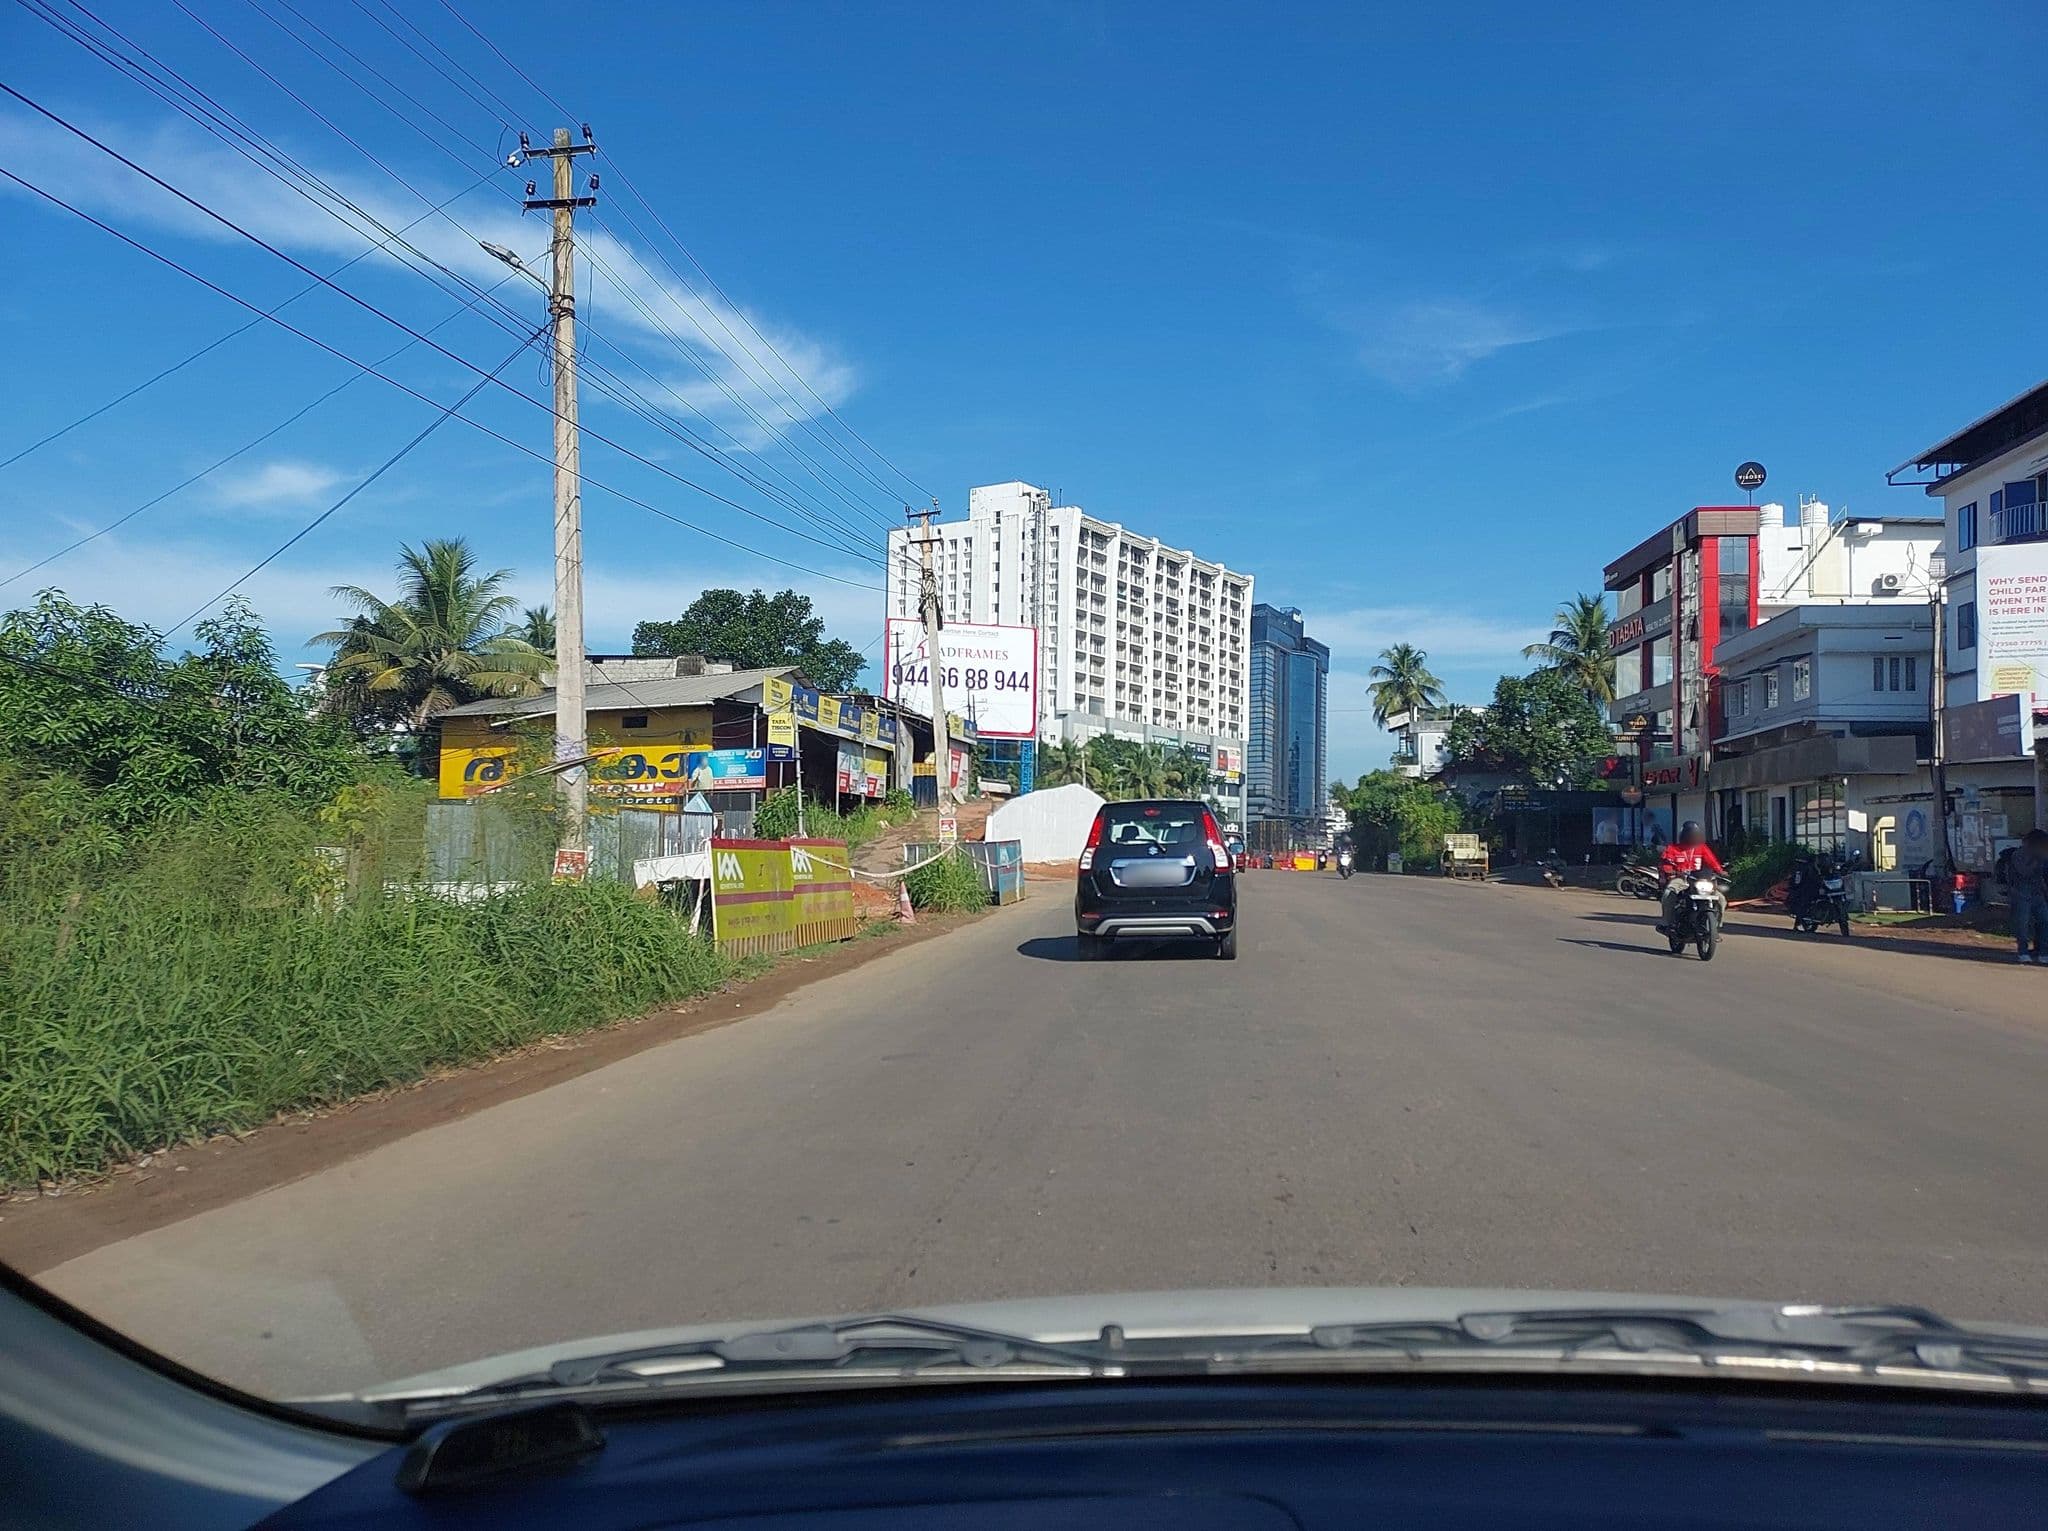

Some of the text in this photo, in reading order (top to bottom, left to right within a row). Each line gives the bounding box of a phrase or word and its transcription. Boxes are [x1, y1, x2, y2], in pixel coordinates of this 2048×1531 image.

[1989, 575, 2048, 586] WHY SEND
[1989, 585, 2047, 596] CHILD FAR
[1989, 595, 2047, 605] WHEN THE
[1989, 608, 1999, 616] IS
[2002, 606, 2031, 615] HERE
[1616, 616, 1645, 645] TABATA
[892, 663, 929, 687] 944
[965, 668, 988, 690] 88
[994, 670, 1030, 692] 944
